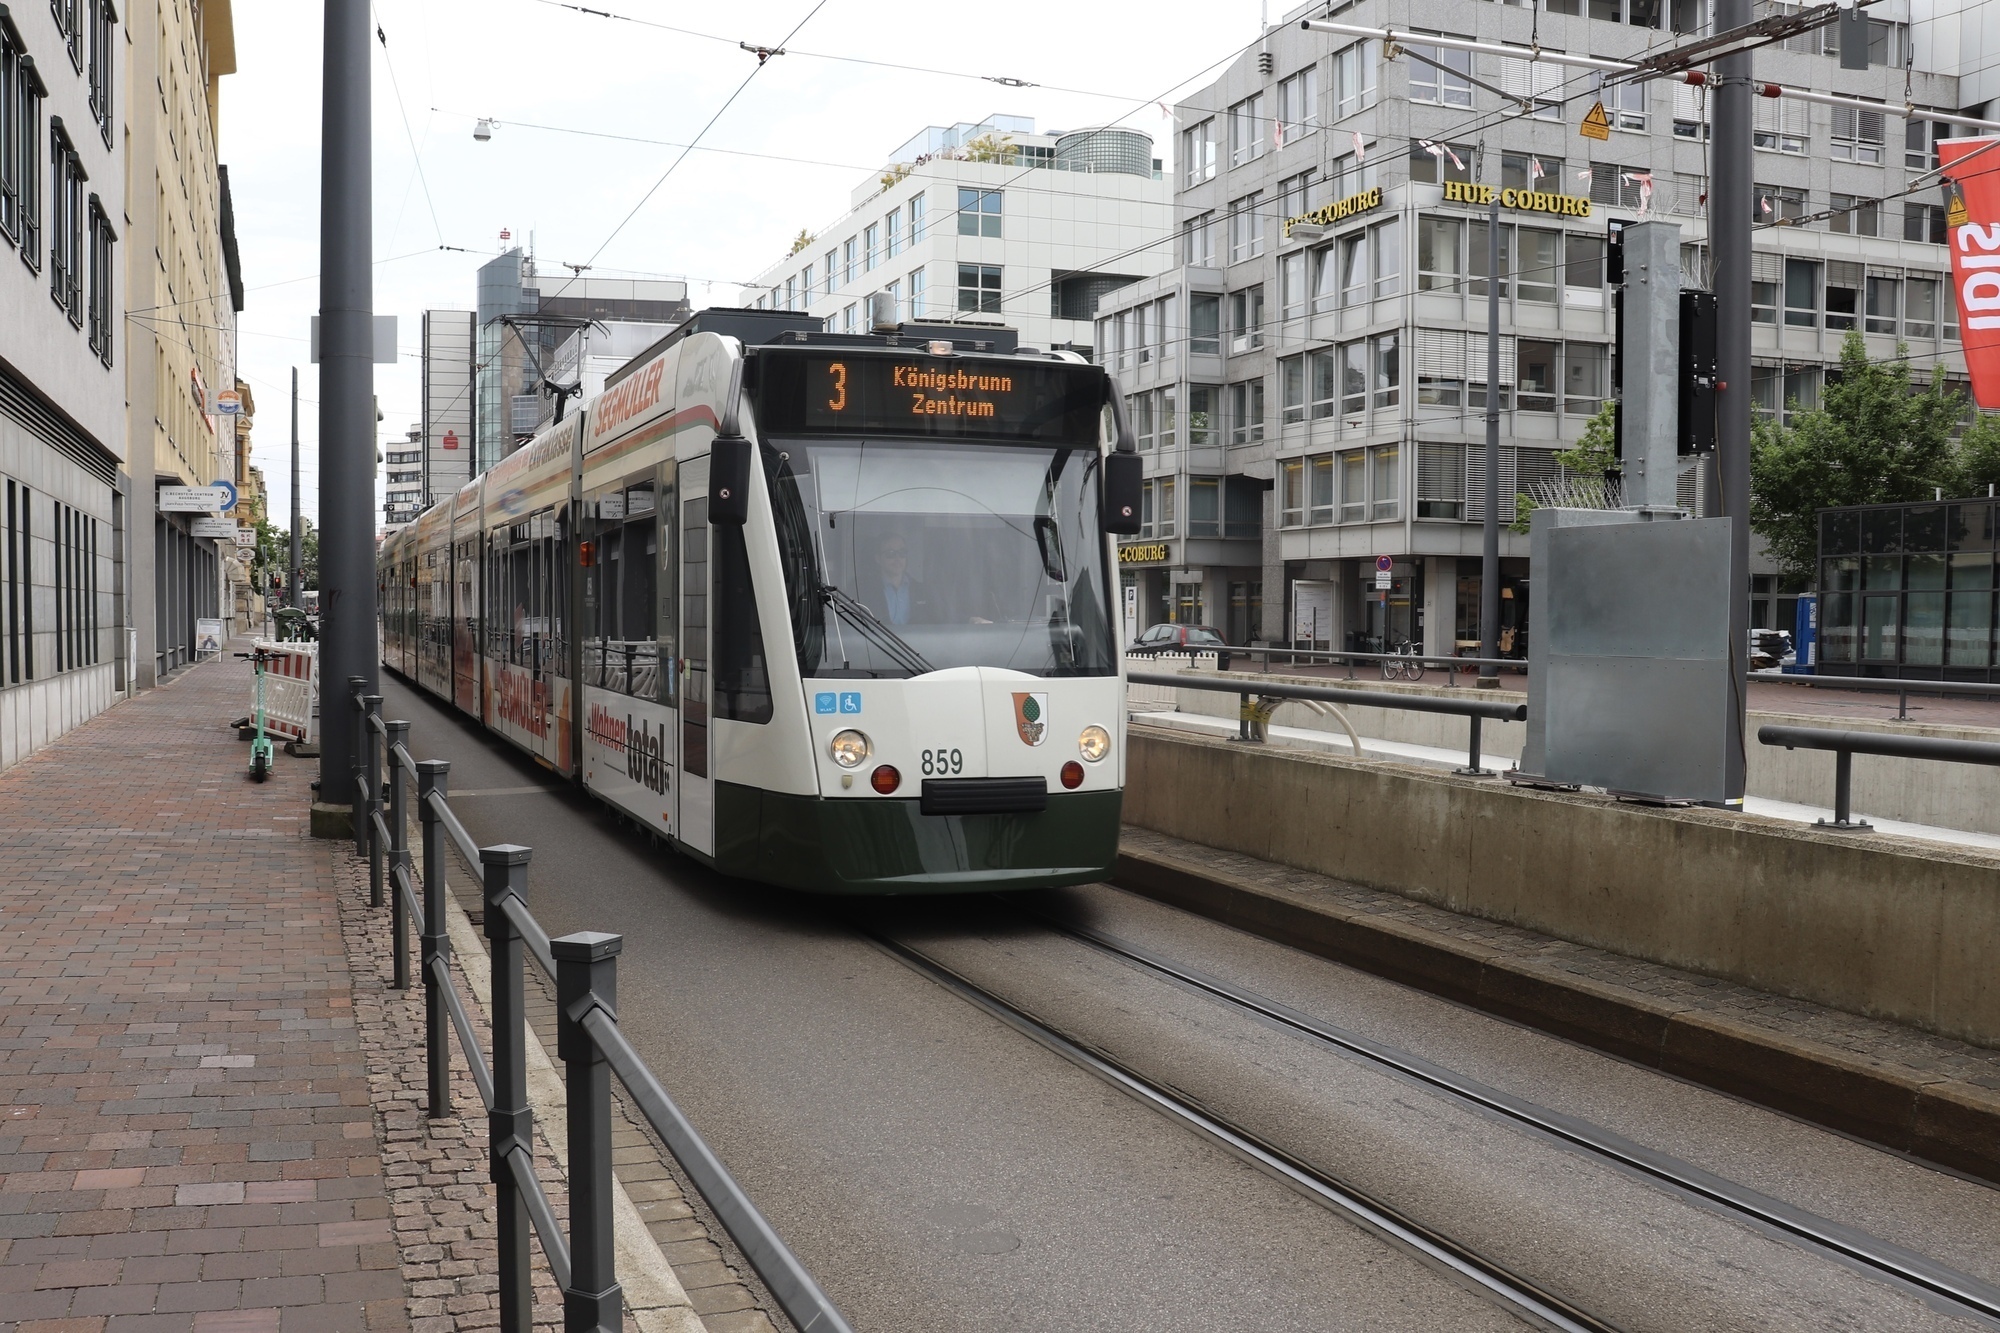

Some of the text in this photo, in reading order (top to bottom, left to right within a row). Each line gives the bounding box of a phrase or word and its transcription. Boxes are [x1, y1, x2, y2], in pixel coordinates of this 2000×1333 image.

[1445, 180, 1592, 217] HUK-COBURG
[594, 357, 665, 438] SEGMÜLLER
[829, 363, 846, 410] 3
[894, 366, 1012, 392] Königsbrunn
[912, 393, 994, 416] Zentrum
[498, 668, 547, 740] SEGMÜLLER
[921, 748, 963, 775] 859
